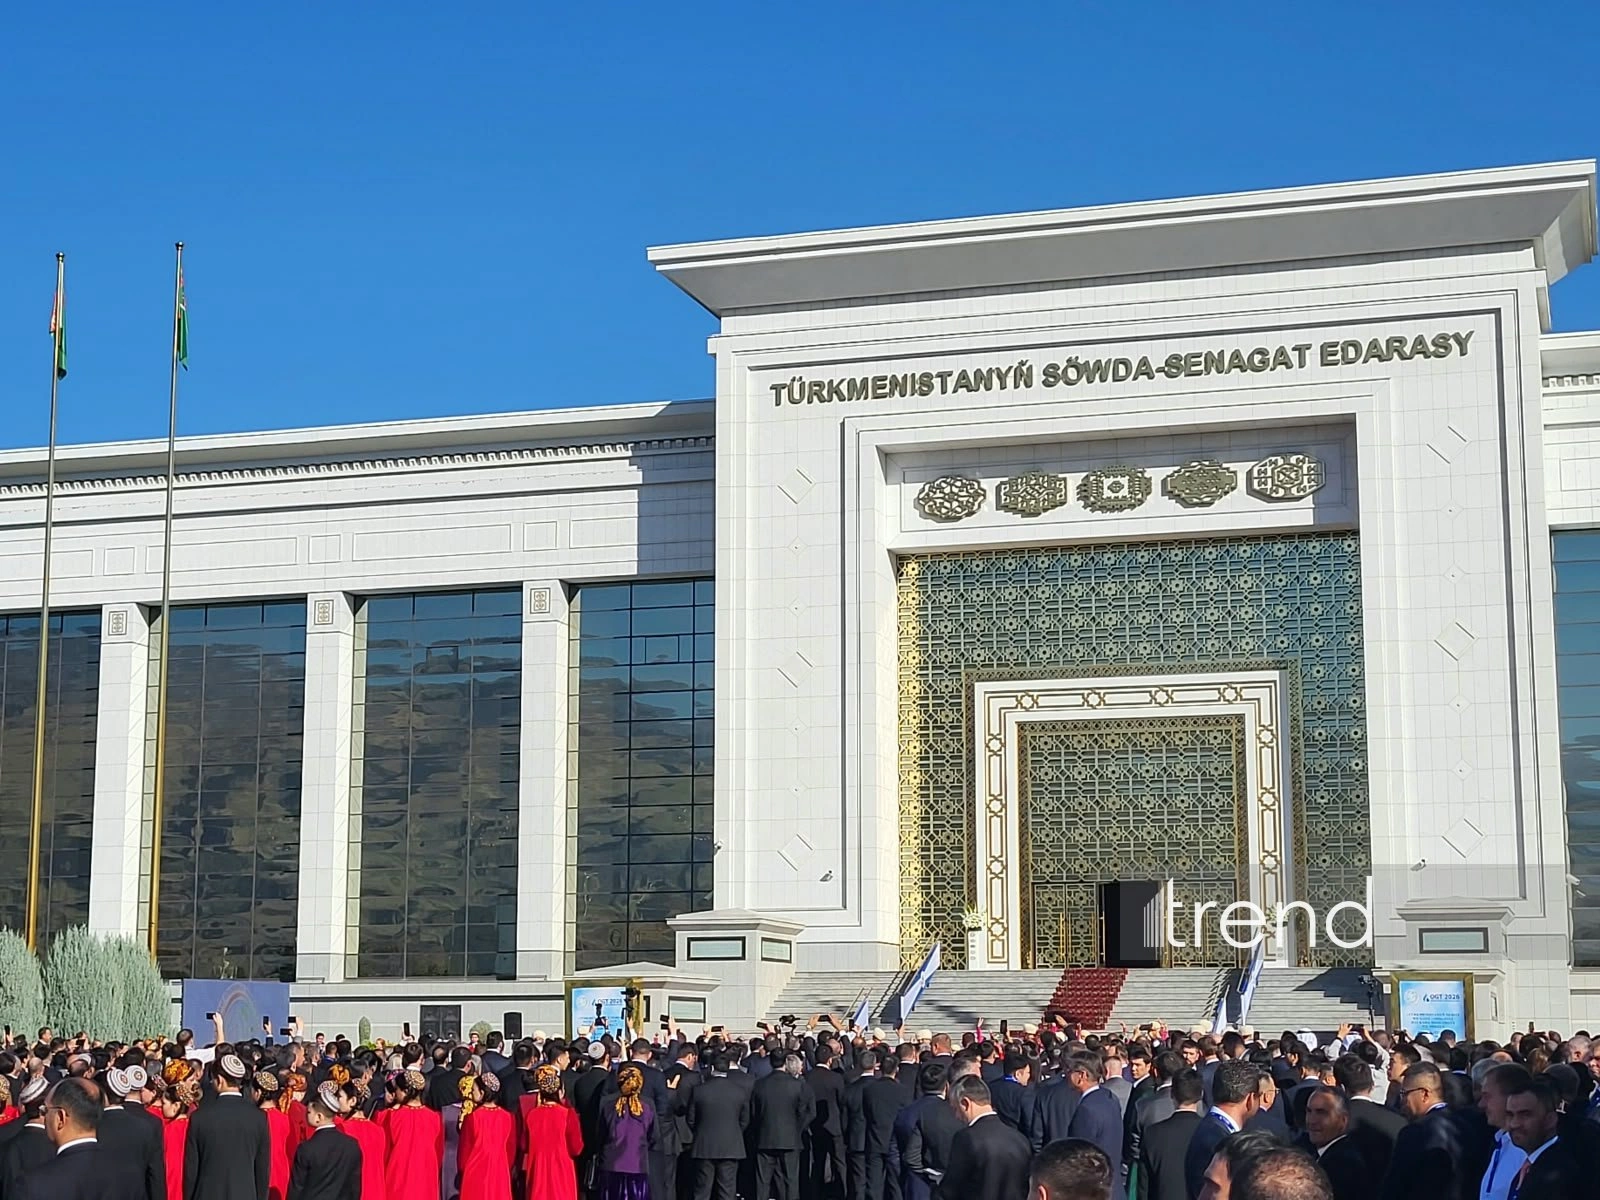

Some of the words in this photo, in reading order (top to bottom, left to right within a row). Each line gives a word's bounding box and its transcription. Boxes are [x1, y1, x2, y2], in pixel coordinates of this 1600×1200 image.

[769, 359, 1034, 407] TÜRKMENISTANYŇ
[1041, 343, 1313, 388] SÖWDA-SENAGAT
[1319, 330, 1475, 367] EDARASY
